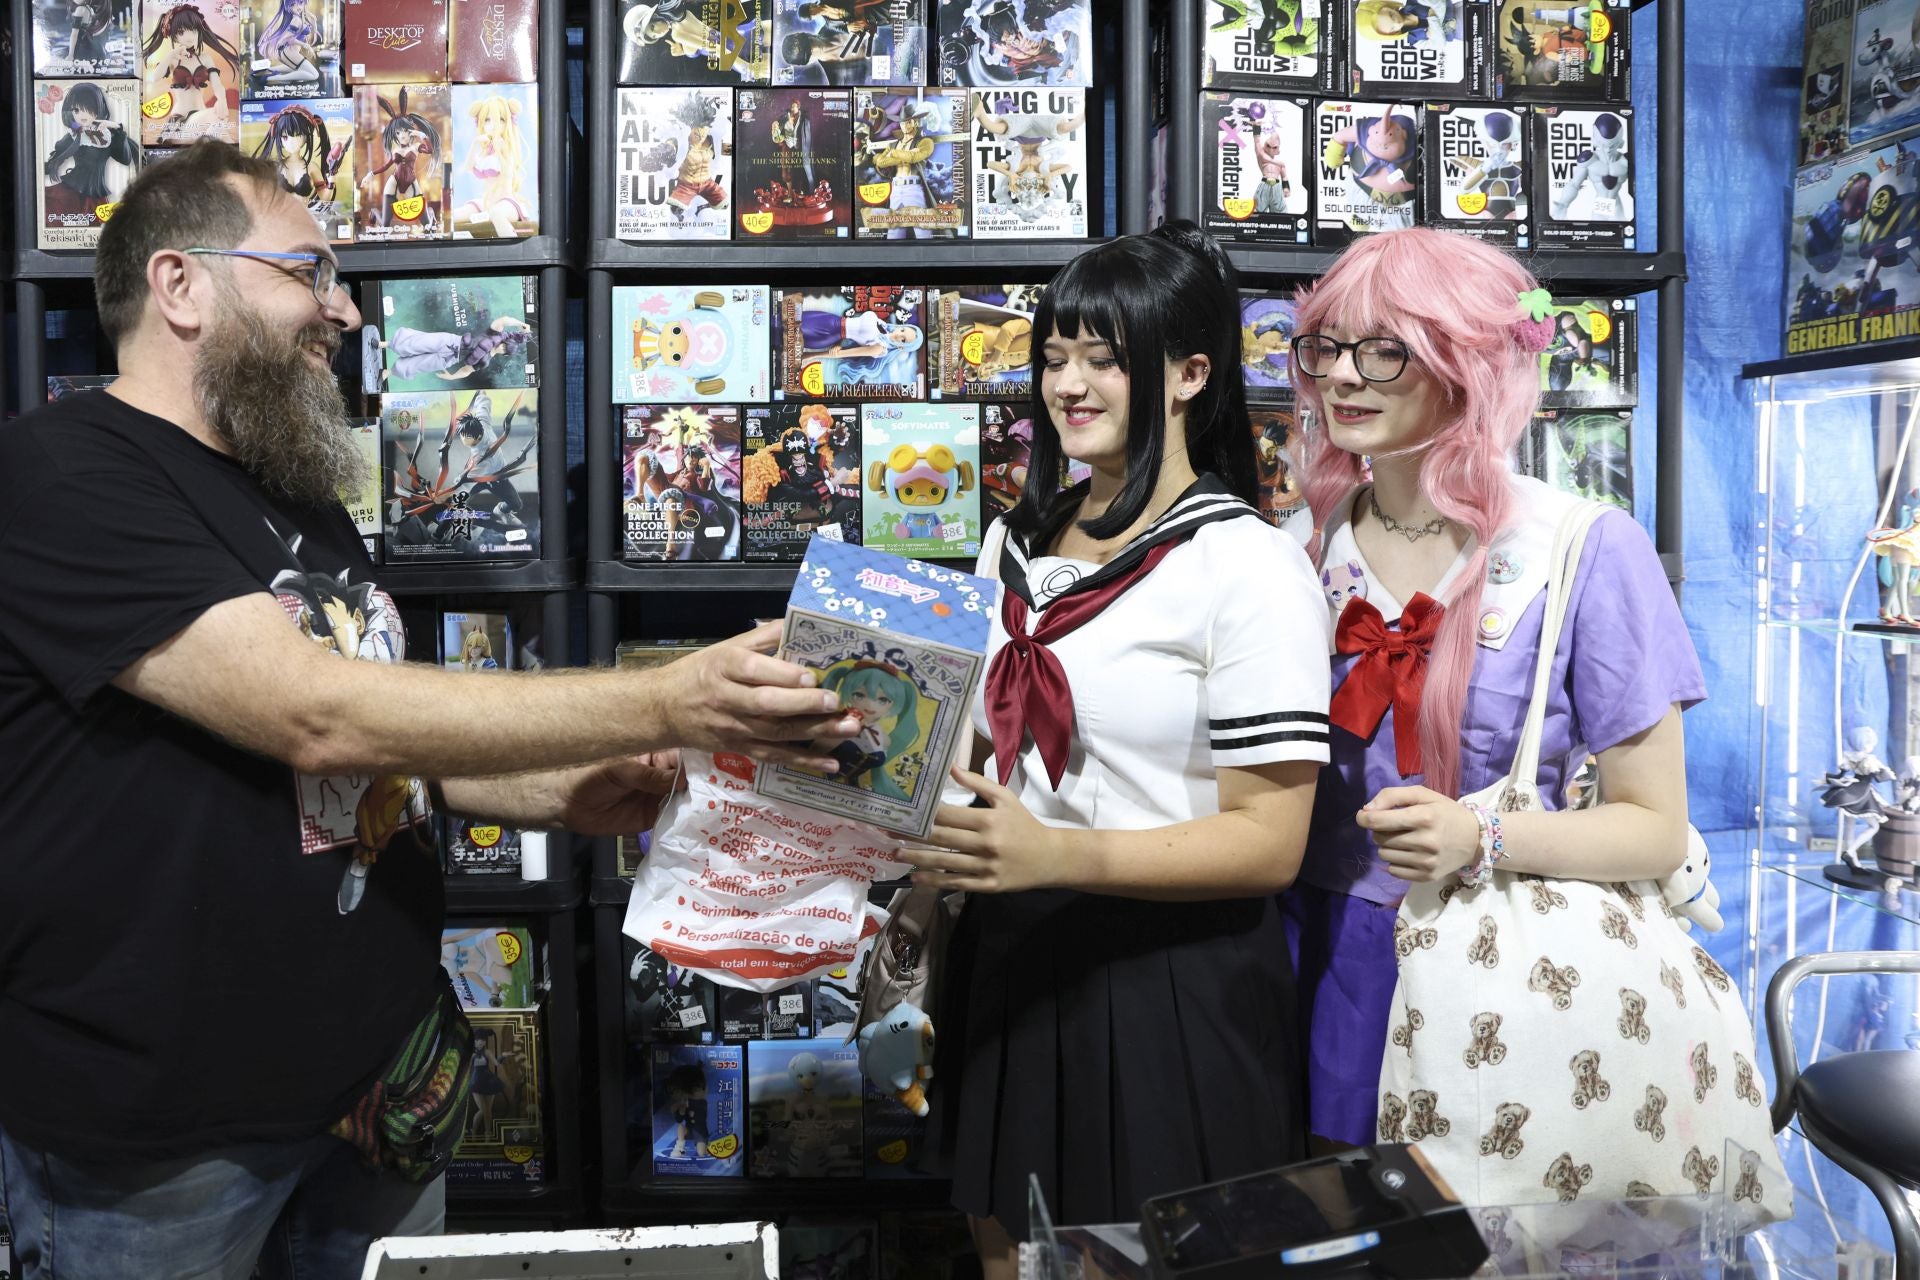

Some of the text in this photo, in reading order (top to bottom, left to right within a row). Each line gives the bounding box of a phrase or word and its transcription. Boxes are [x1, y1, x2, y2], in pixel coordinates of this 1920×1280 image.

[367, 27, 425, 39] DESKTOP
[493, 4, 505, 61] DESKTOP
[1593, 17, 1606, 40] 35€
[382, 35, 410, 49] Cute
[1570, 47, 1580, 82] SON GOKU
[145, 97, 170, 115] 35€
[976, 91, 1038, 114] KING
[1550, 123, 1591, 140] SOL
[863, 185, 888, 199] 40€
[396, 200, 421, 216] 35€
[1325, 204, 1412, 216] SOLID EDGE WORKS
[745, 215, 770, 228] 40€
[450, 283, 462, 328] FUSHIGURO
[459, 308, 468, 327] TOJI
[1788, 320, 1857, 354] GENERAL
[967, 335, 981, 360] 30€
[634, 373, 647, 393] 38€
[808, 367, 820, 390] 40€
[891, 421, 951, 431] SOFVIMATES
[628, 502, 682, 512] ONE PIECE
[747, 502, 801, 512] ONE PIECE
[628, 512, 666, 521] BATTLE
[747, 512, 785, 521] BATTLE
[628, 522, 671, 531] RECORD
[747, 522, 791, 531] RECORD
[943, 527, 964, 539] 38€
[628, 531, 695, 541] COLLECTION
[747, 531, 815, 541] COLLECTION
[447, 614, 467, 622] SEGA
[786, 629, 858, 654] WONDER
[919, 651, 965, 694] LAND
[474, 829, 497, 842] 30€
[454, 847, 521, 862] チェンソーマ
[780, 861, 877, 880] Acabamento
[677, 926, 816, 947] Personalização de
[500, 936, 517, 960] 35€
[720, 954, 817, 969] total em serviços
[782, 999, 802, 1009] 38€
[684, 1010, 704, 1023] 38€
[710, 1138, 736, 1156] 35€
